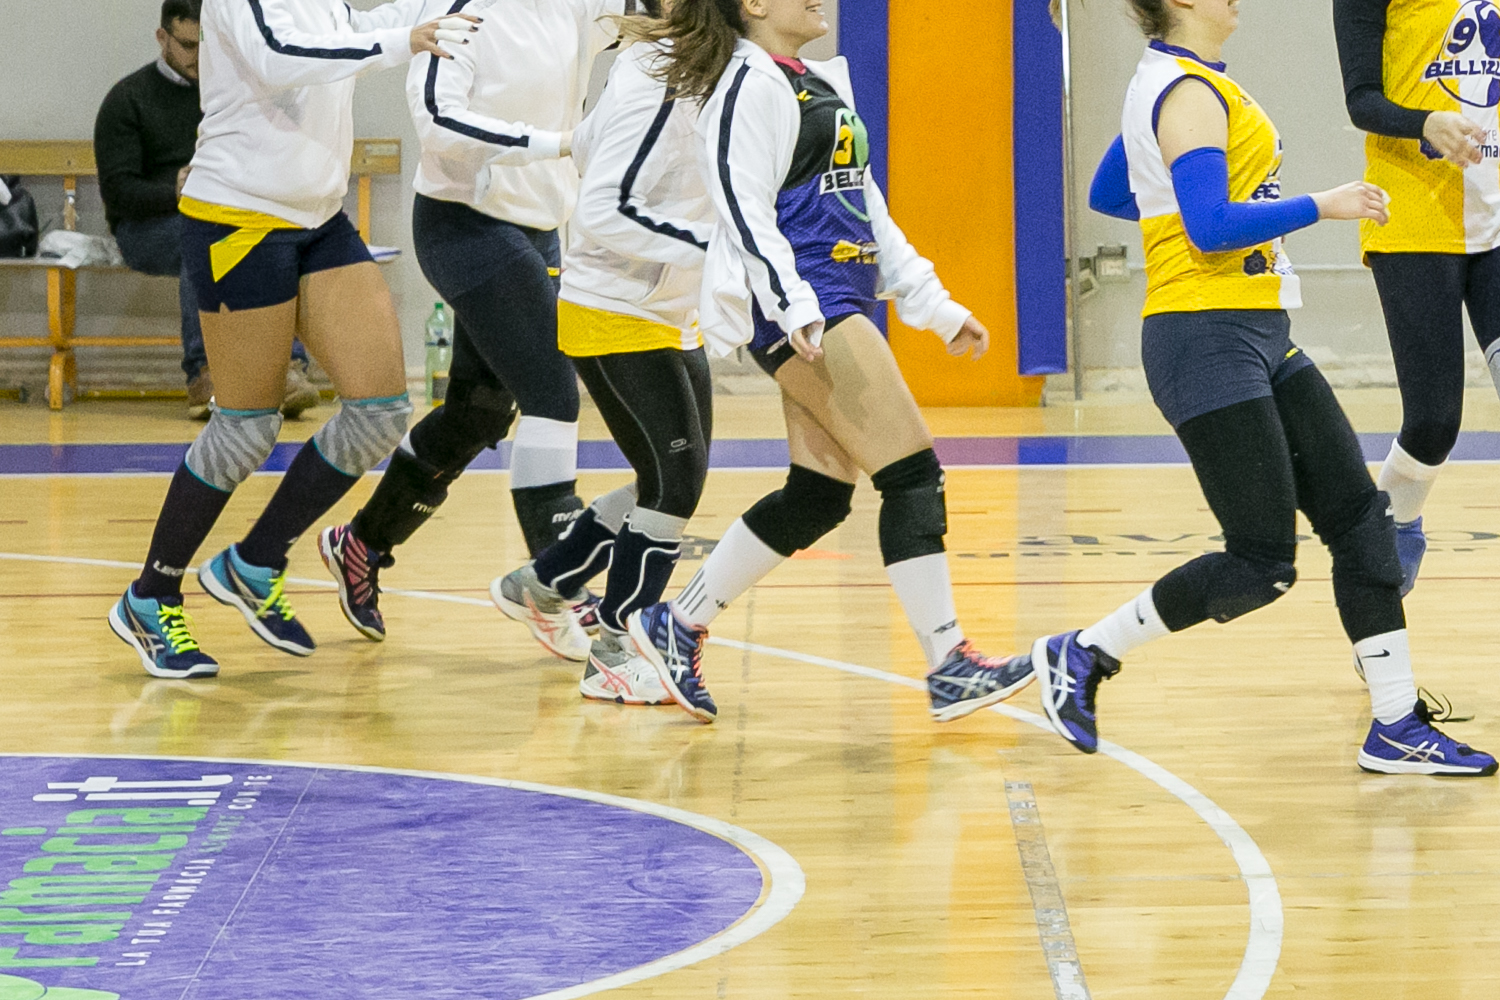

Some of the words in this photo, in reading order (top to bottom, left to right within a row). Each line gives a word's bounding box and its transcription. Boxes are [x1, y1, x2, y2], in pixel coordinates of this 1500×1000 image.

[1447, 18, 1477, 54] 9
[131, 921, 173, 944] TUA
[115, 951, 152, 966] LA
